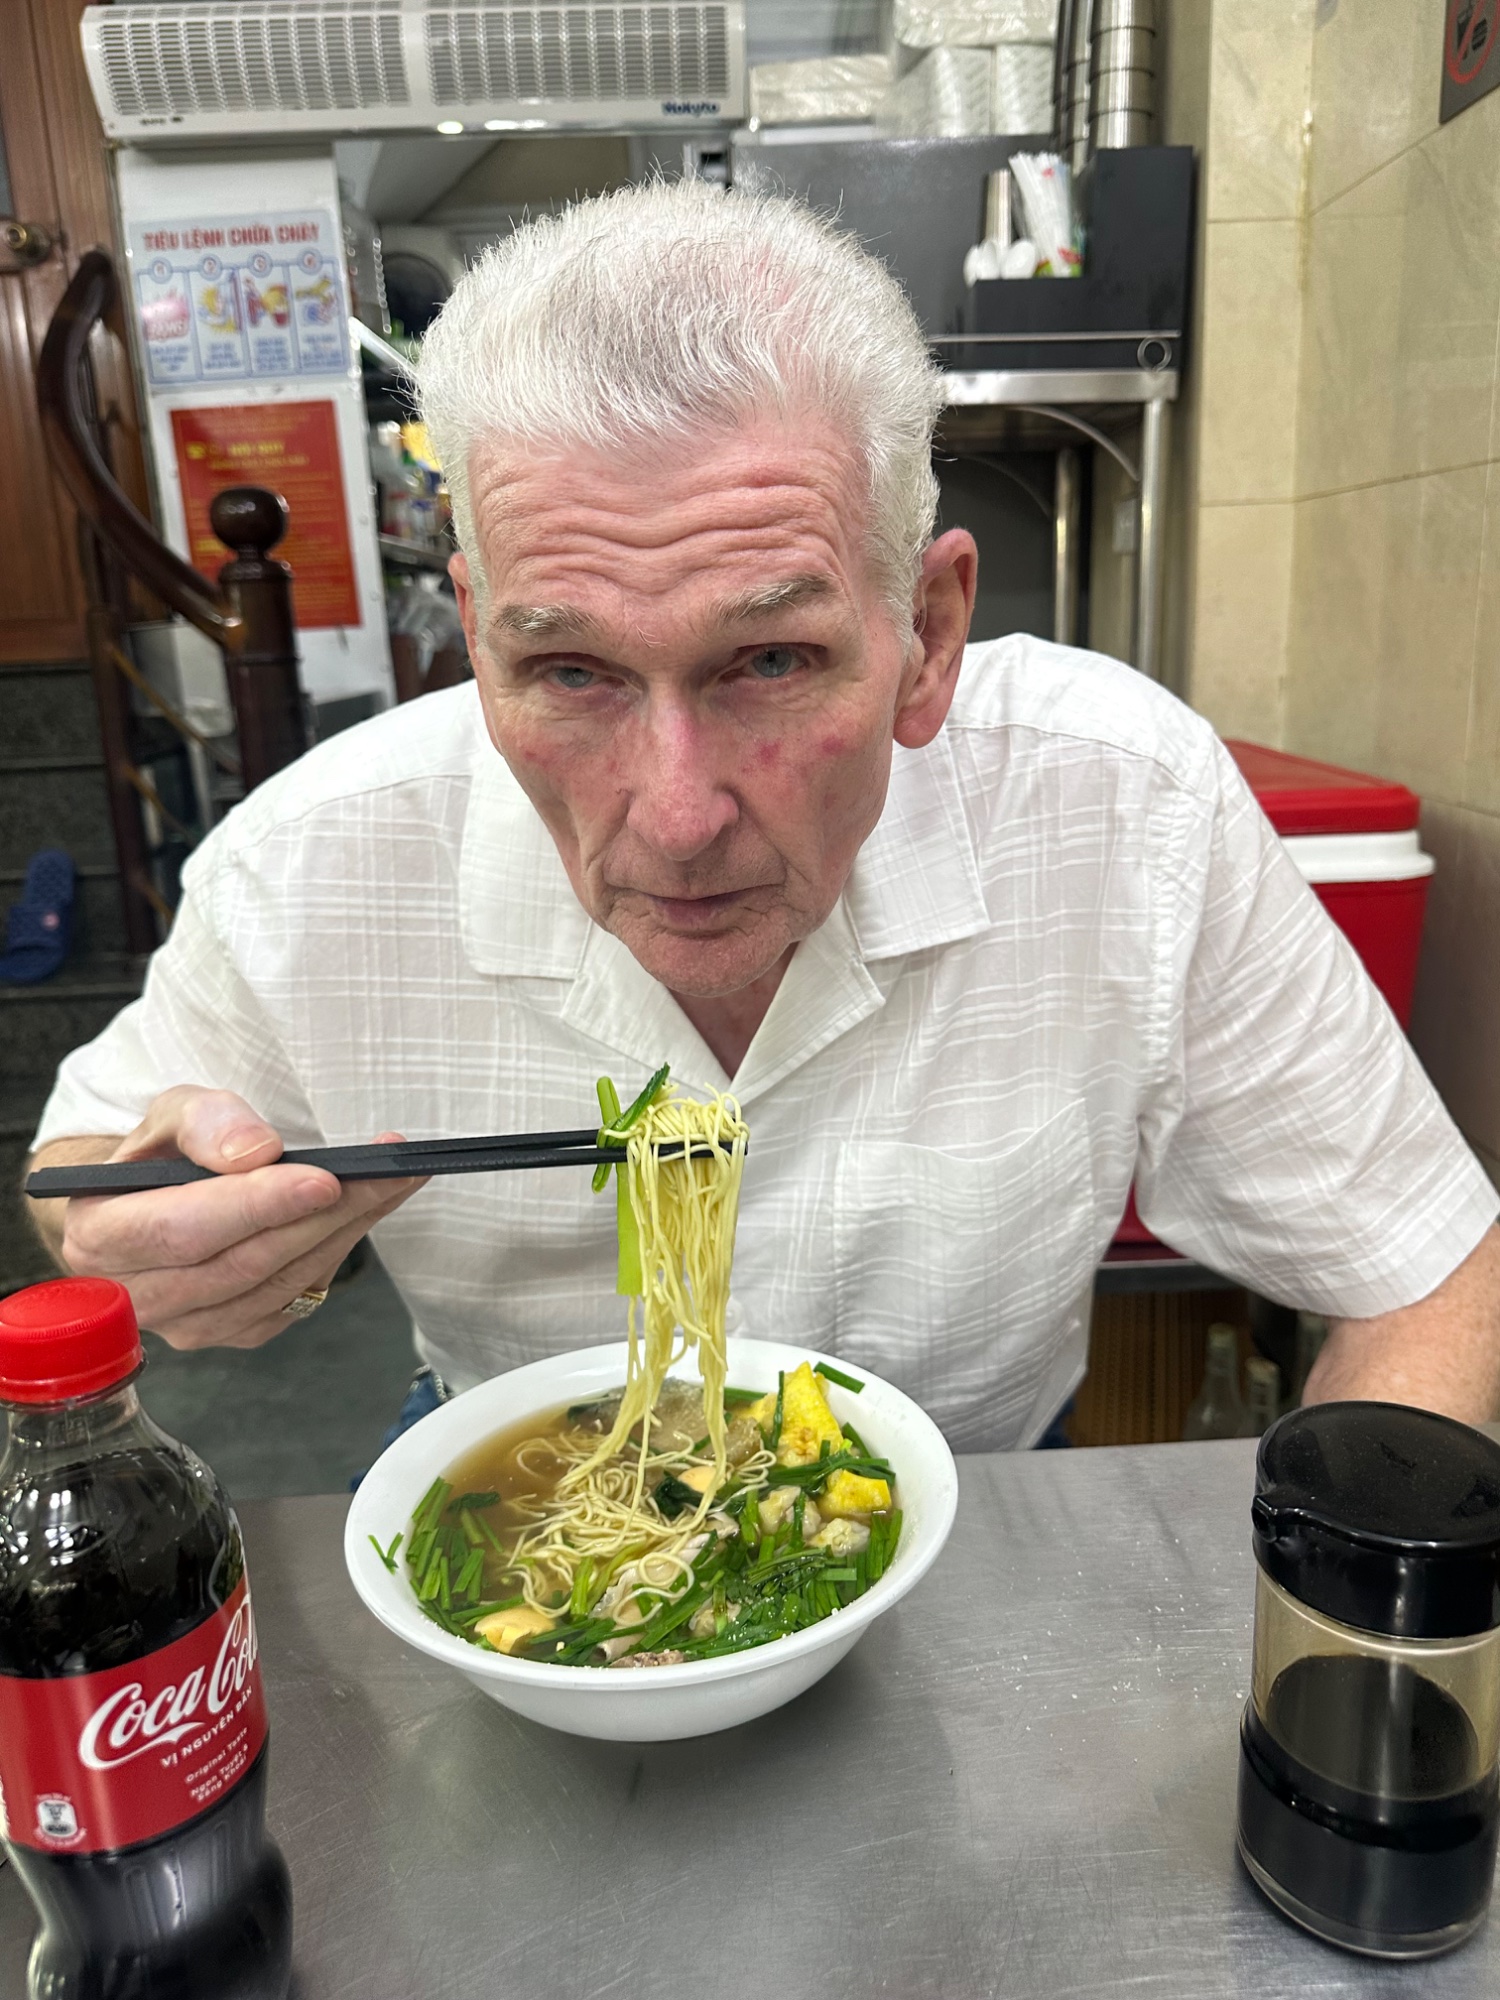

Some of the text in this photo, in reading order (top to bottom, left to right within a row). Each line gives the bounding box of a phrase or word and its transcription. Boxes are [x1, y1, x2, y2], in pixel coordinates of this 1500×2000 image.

[78, 1665, 206, 1771] Coca
[161, 1752, 179, 1769] VỊ
[181, 1709, 235, 1758] NGUYÊN
[185, 1726, 248, 1784] Original Taste
